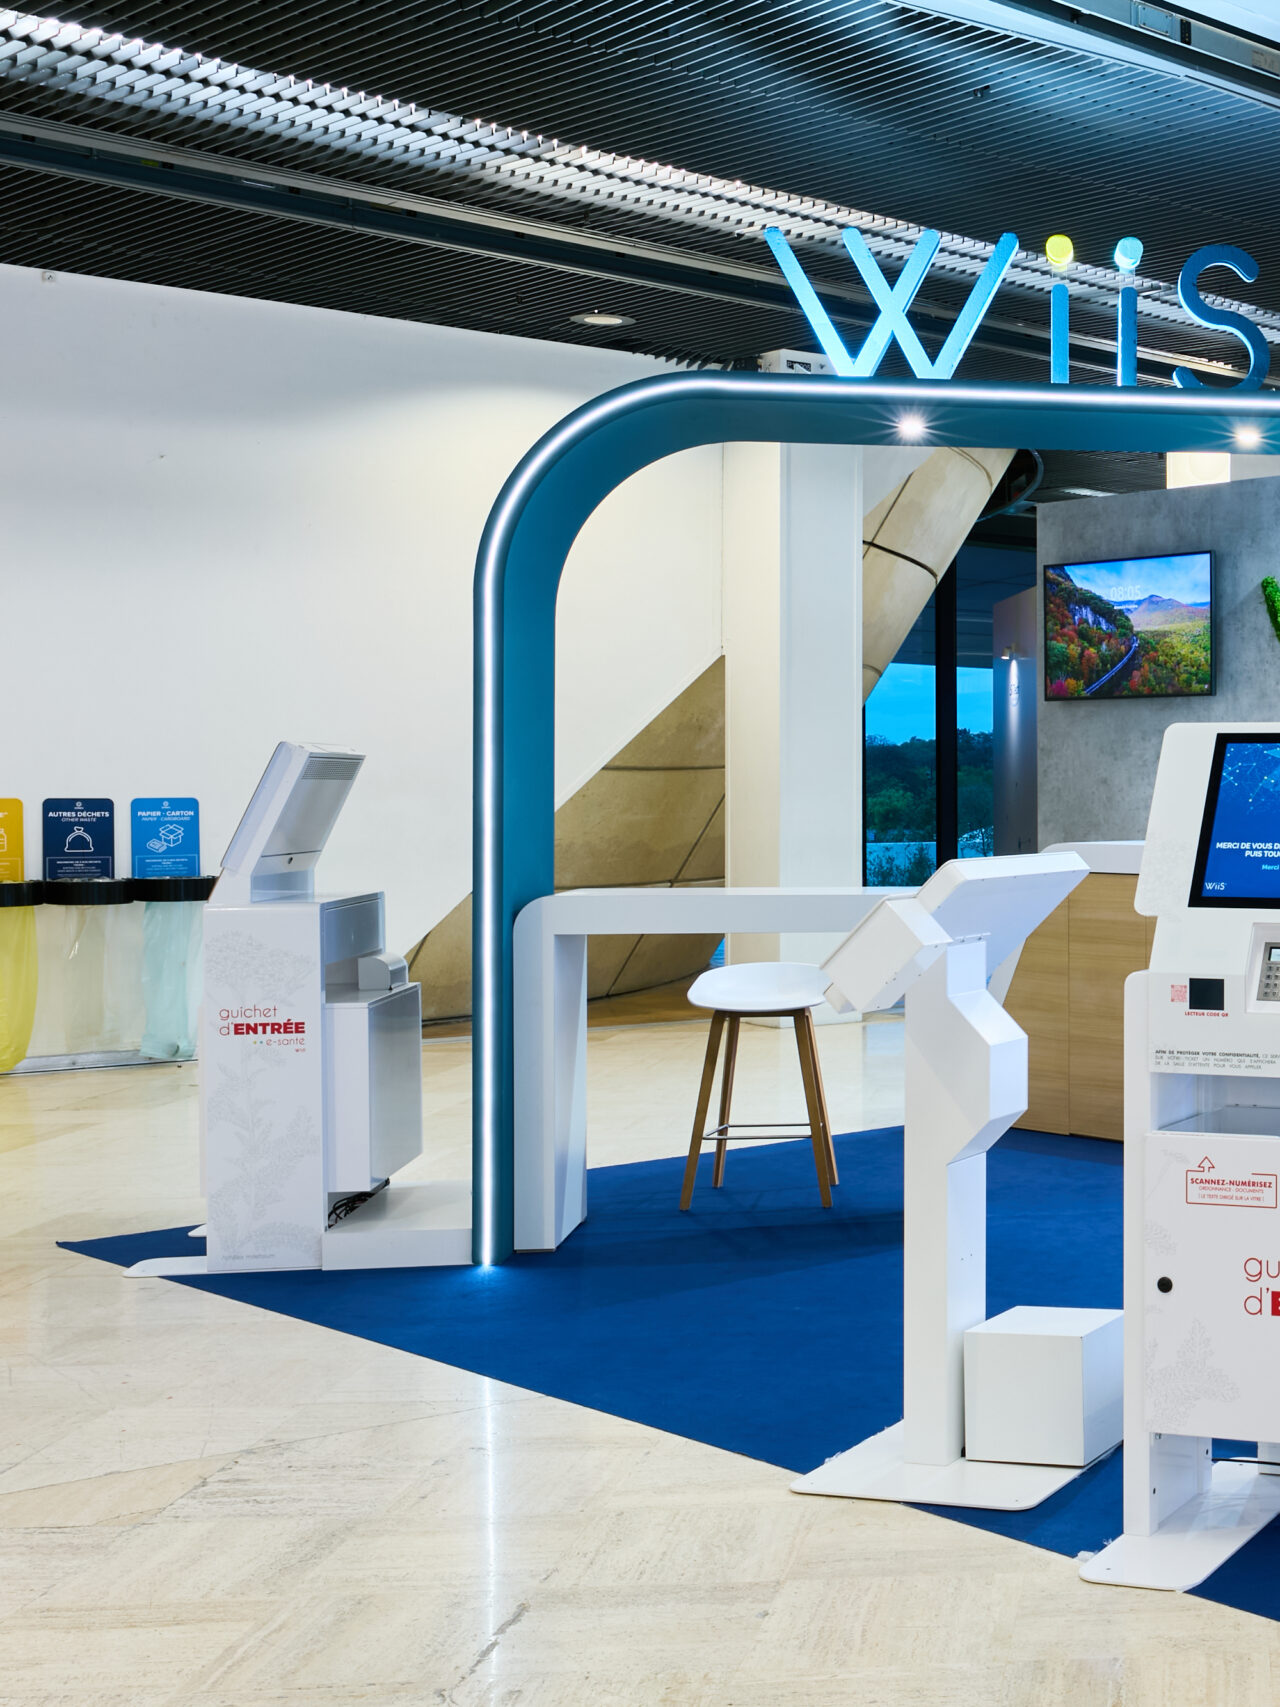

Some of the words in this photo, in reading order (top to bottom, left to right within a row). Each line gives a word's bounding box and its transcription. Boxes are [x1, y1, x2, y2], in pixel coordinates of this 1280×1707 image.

[763, 225, 1271, 391] WiiS
[77, 810, 110, 818] DÉCHETS
[1241, 842, 1251, 850] DE
[1252, 842, 1273, 850] VOUS
[1245, 850, 1262, 858] PUIS
[1205, 882, 1225, 890] WiiS
[219, 1004, 278, 1021] guichet
[219, 1018, 306, 1036] d'ENTRÉE
[1190, 1177, 1273, 1189] SCANNEZ-NUMÉRISEZ
